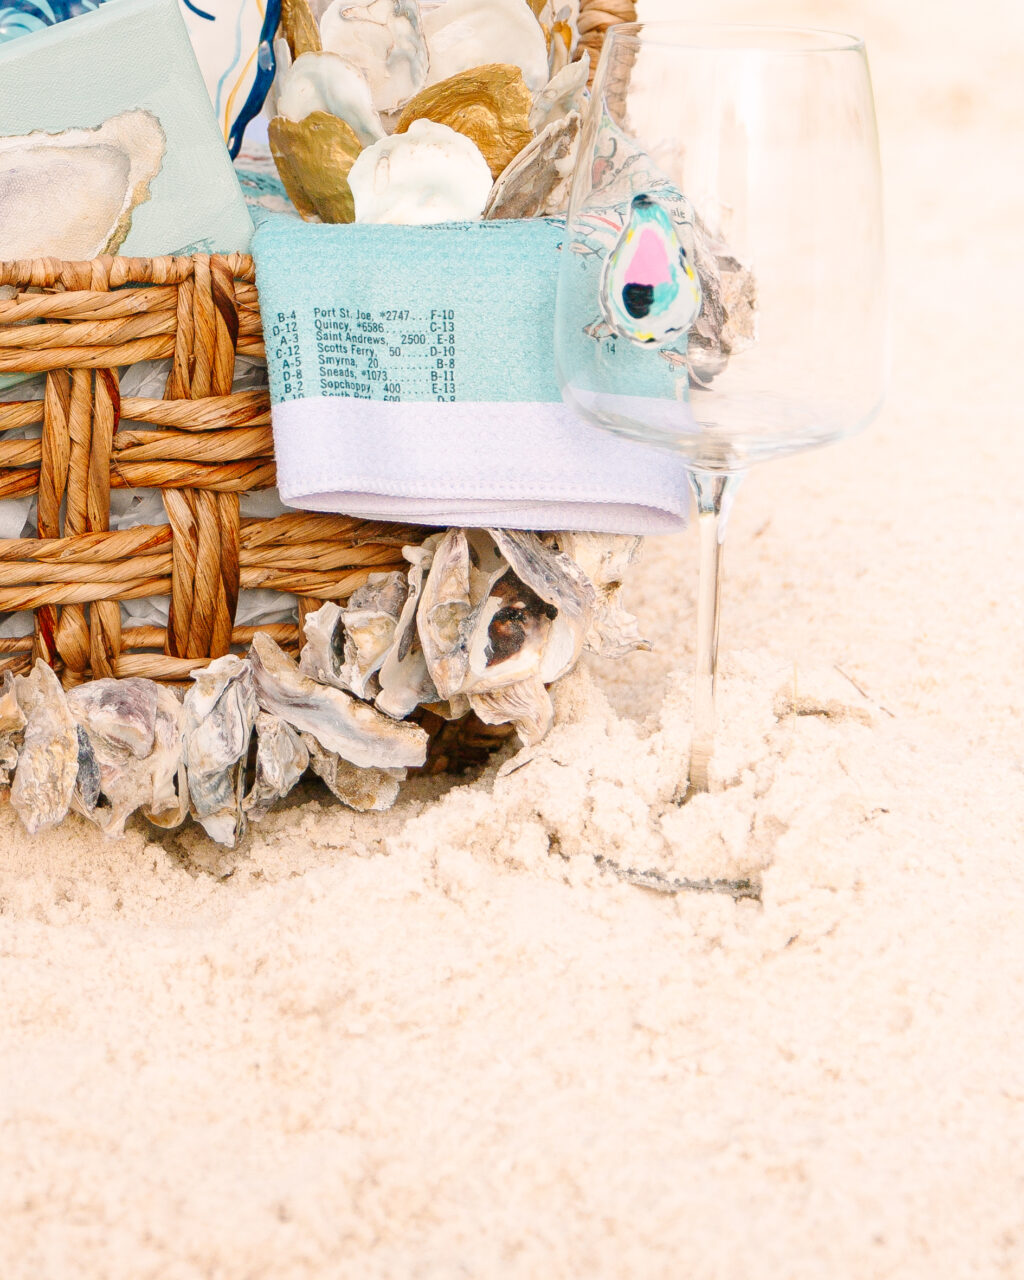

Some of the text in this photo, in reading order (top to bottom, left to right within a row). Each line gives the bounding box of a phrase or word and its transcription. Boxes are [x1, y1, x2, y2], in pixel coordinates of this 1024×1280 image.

[278, 310, 296, 323] B-4
[314, 308, 336, 319] Port
[339, 308, 353, 319] St.
[357, 309, 375, 322] Joe,
[430, 309, 455, 320] F-10
[273, 322, 297, 336] D-12
[314, 319, 353, 333] Quincy,
[430, 322, 455, 332] C-13
[280, 333, 299, 346] A-3
[316, 331, 455, 346] Saint Andrews, 2500 E-8
[276, 345, 300, 359] C-12
[317, 343, 455, 358] Scotts Ferry, 50 D-10
[282, 356, 302, 369] A-5
[318, 355, 455, 369] Smyrna, 20 B-8
[283, 368, 303, 381] D-8
[319, 367, 357, 380] Sneads,
[430, 371, 455, 381] B-11
[285, 381, 304, 394] B-2
[320, 379, 456, 394] Sopchoppy, 400 E-13
